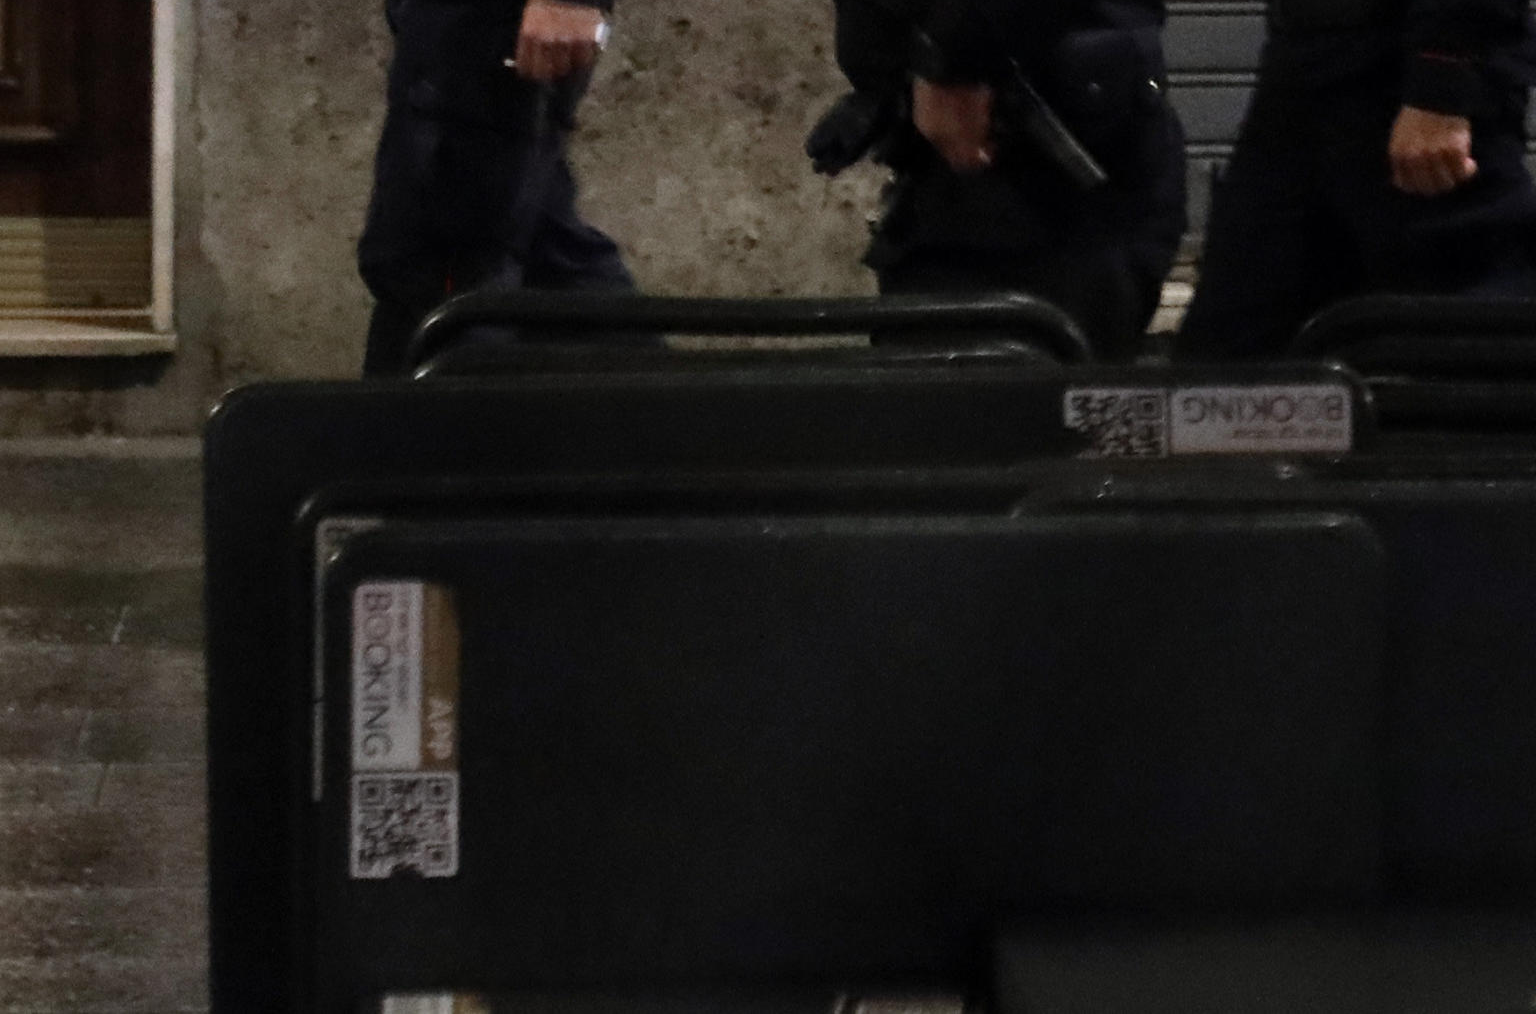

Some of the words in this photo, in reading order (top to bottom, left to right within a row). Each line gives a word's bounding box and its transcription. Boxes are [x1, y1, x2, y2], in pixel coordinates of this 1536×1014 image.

[1184, 395, 1344, 423] BOOKING
[362, 592, 393, 756] BOOKING
[428, 698, 454, 759] APP
